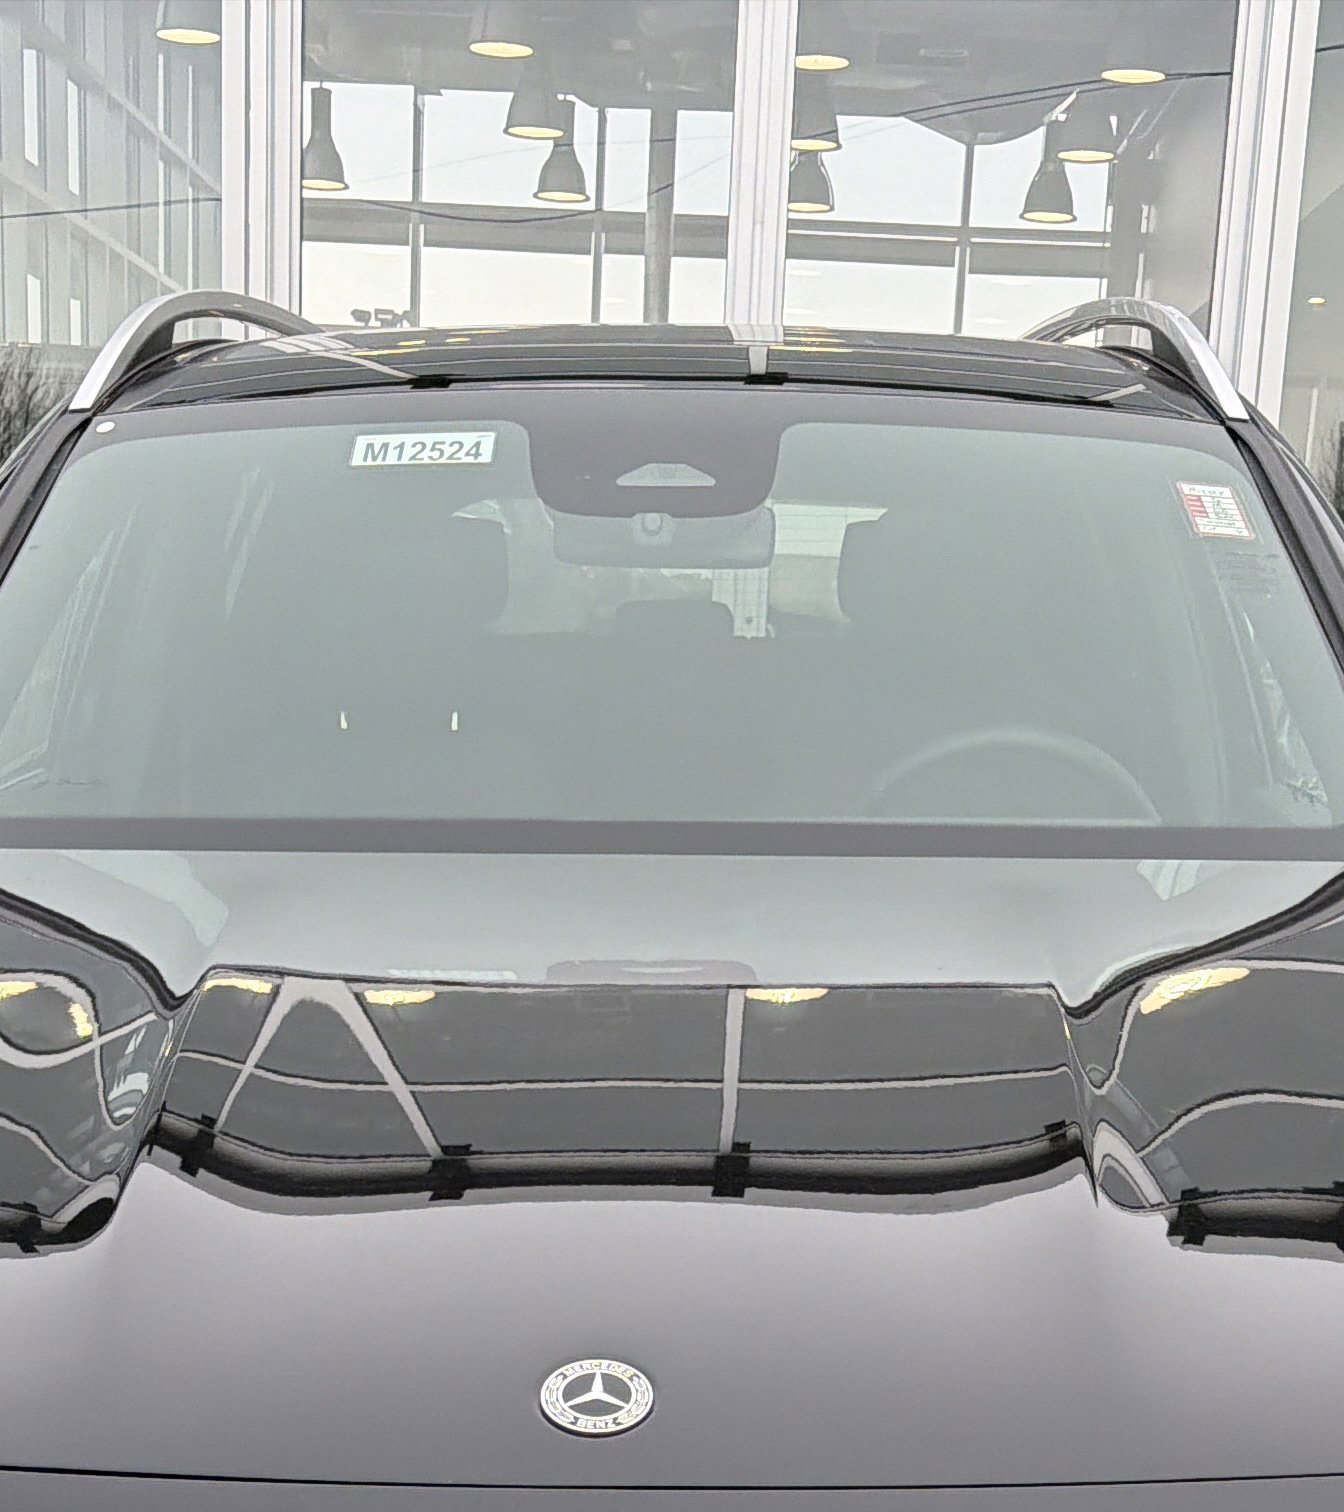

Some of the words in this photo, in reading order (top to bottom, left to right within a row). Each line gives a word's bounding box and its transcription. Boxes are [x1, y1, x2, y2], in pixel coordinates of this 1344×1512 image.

[362, 440, 483, 463] M12524
[562, 1361, 635, 1378] MERCEDES
[576, 1419, 616, 1429] BENZ
